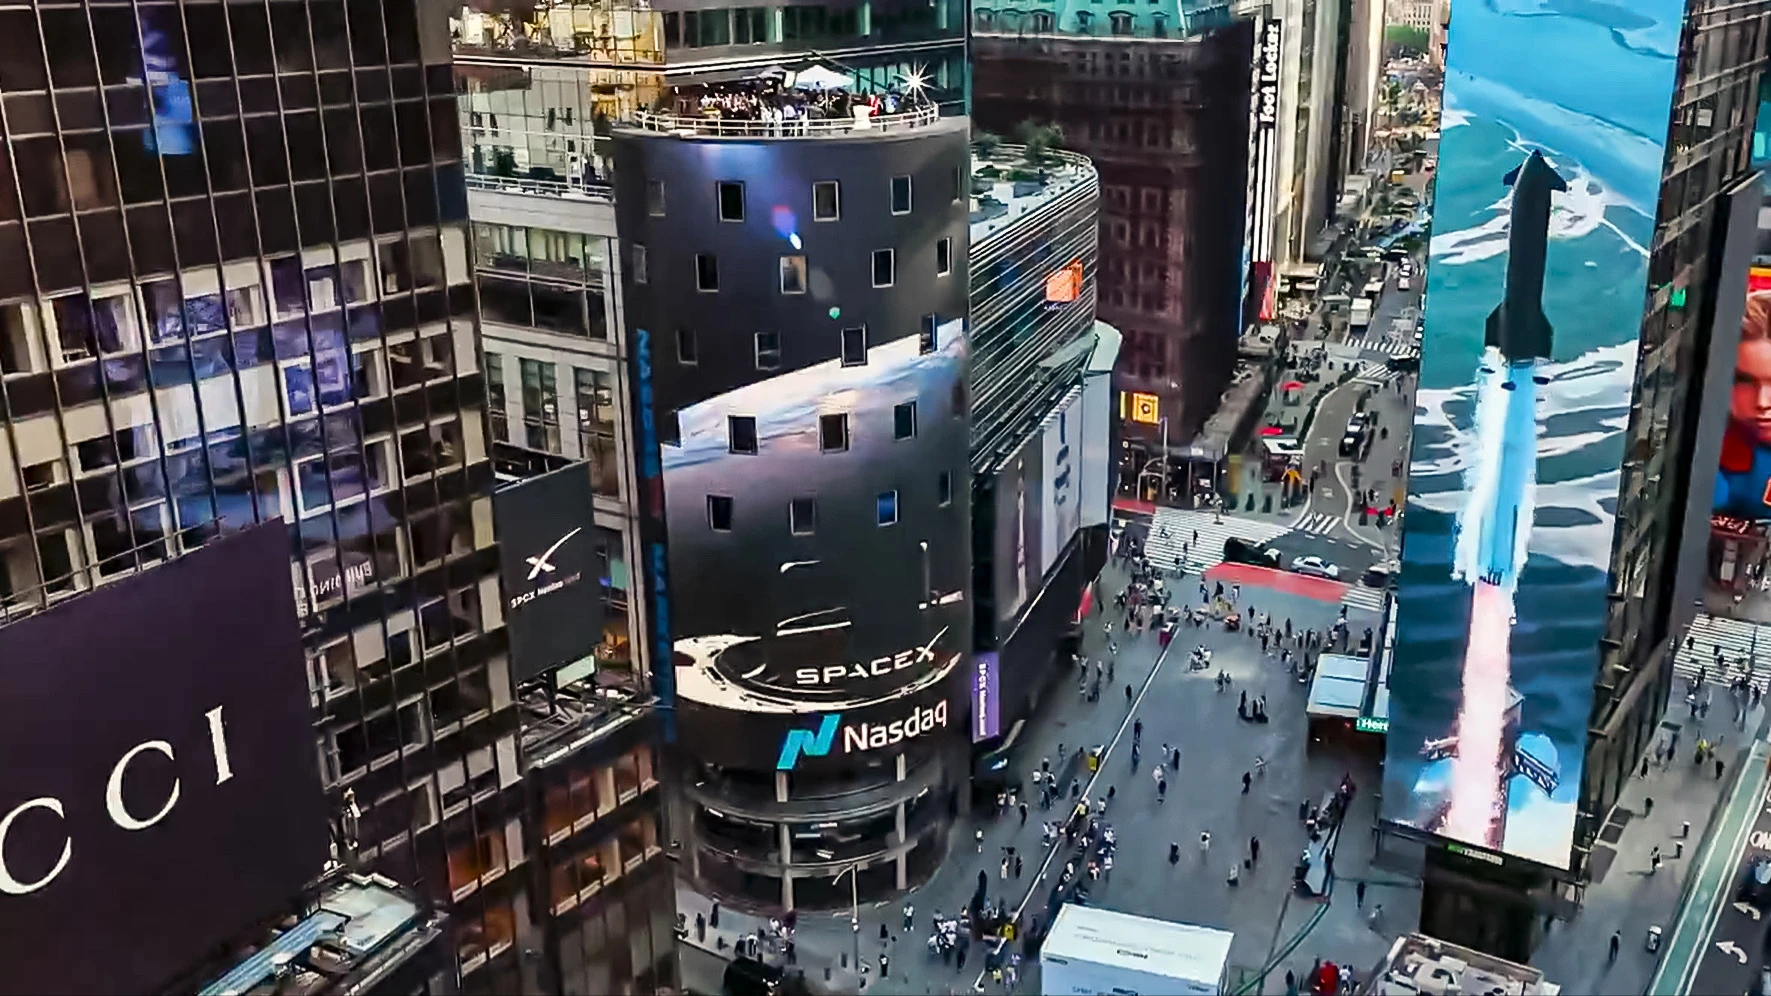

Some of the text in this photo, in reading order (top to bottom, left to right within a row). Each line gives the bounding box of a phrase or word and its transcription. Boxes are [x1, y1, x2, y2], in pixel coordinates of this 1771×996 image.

[1260, 24, 1279, 122] Foot Locker
[795, 625, 949, 685] SPACEX
[843, 699, 948, 754] Nasdaq
